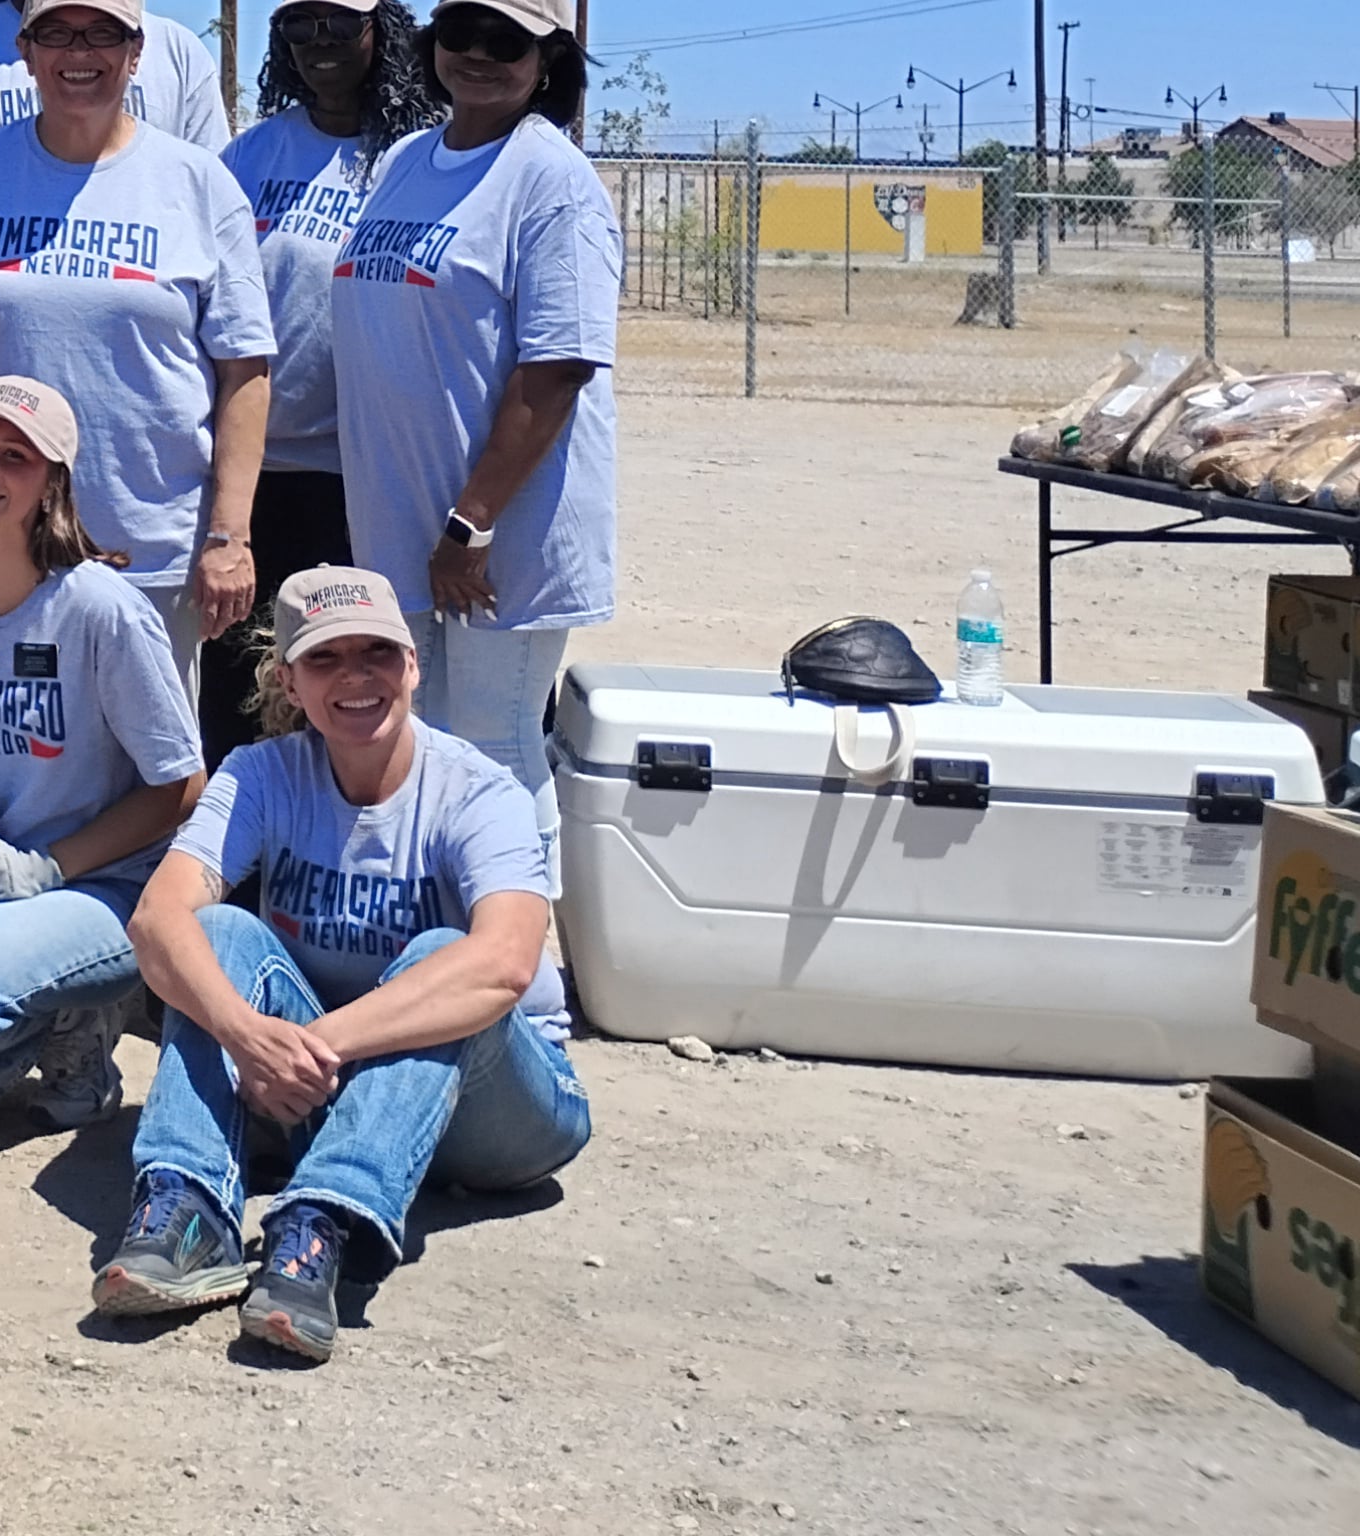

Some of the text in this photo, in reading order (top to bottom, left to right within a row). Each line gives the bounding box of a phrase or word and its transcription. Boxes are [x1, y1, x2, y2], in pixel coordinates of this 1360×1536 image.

[270, 214, 342, 244] NEVADA
[25, 254, 110, 279] NEVADA
[354, 256, 407, 284] NEVADA
[303, 583, 370, 613] AMERICA250
[267, 847, 445, 937] AMERICA250
[303, 917, 396, 958] NEVADA
